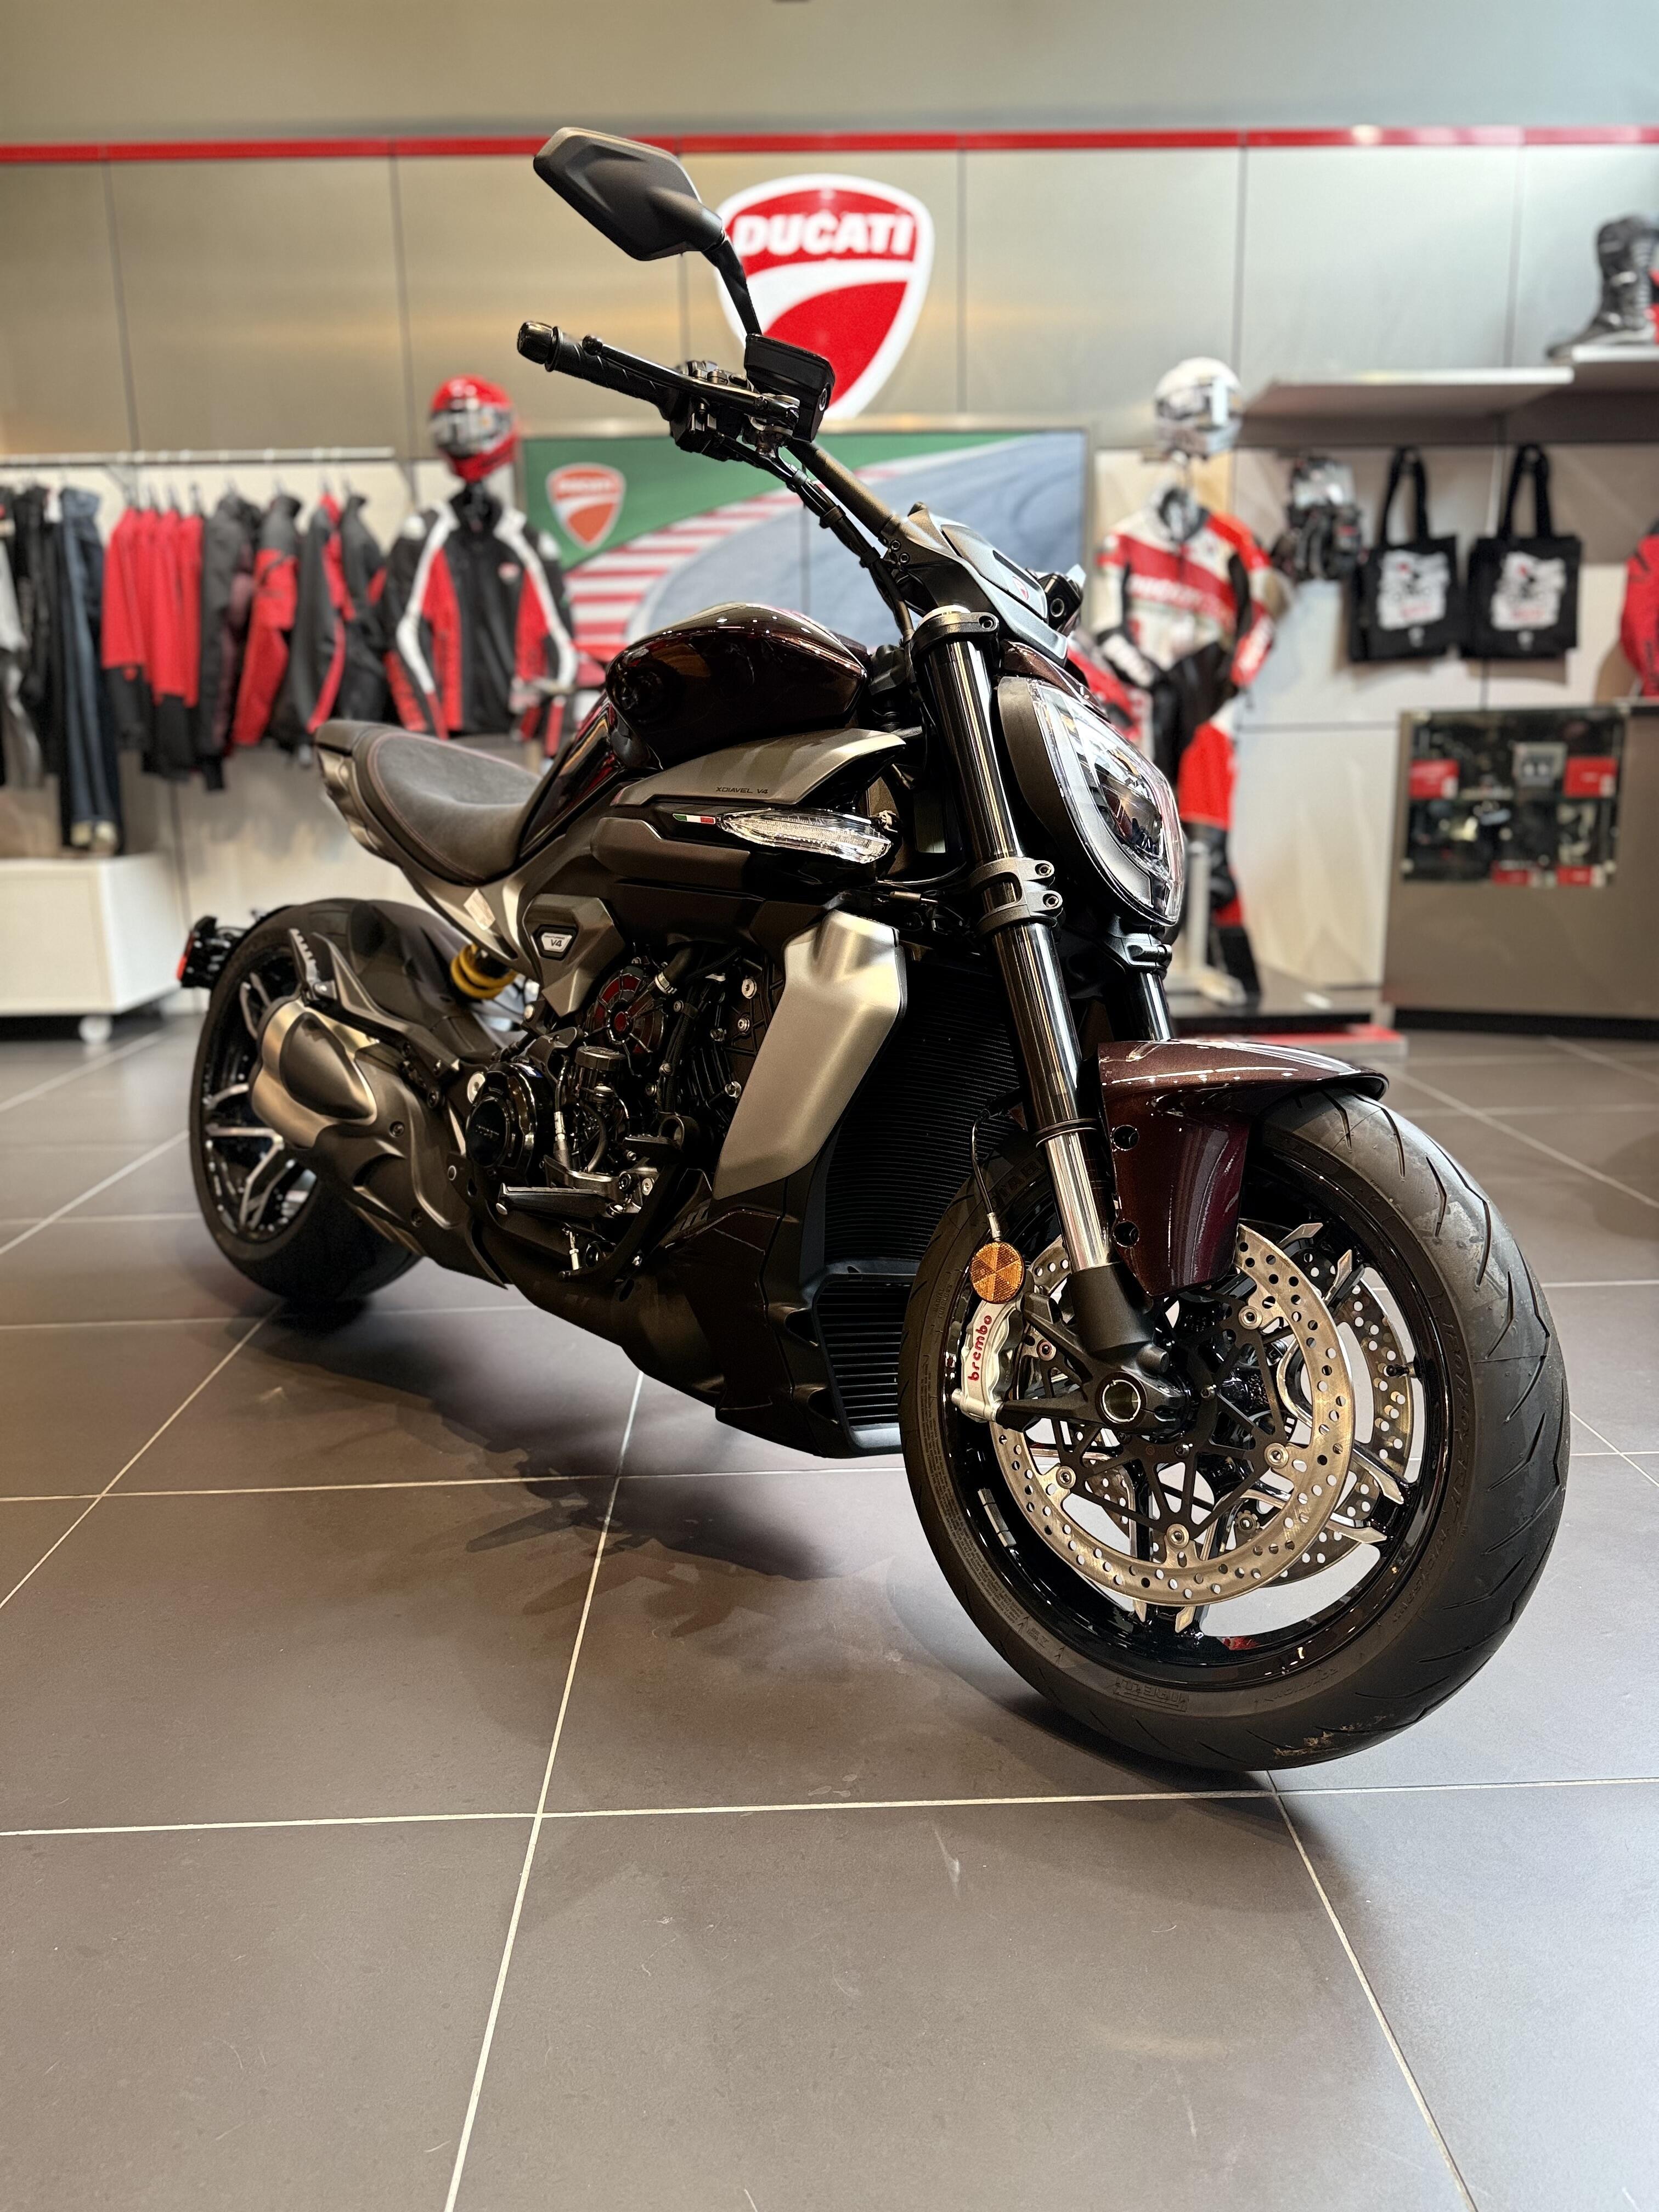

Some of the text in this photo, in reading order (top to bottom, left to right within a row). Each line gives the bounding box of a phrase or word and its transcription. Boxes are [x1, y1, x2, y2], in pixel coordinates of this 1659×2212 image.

[732, 212, 915, 255] DUCATI
[550, 939, 562, 947] V4
[967, 1315, 992, 1381] brembo
